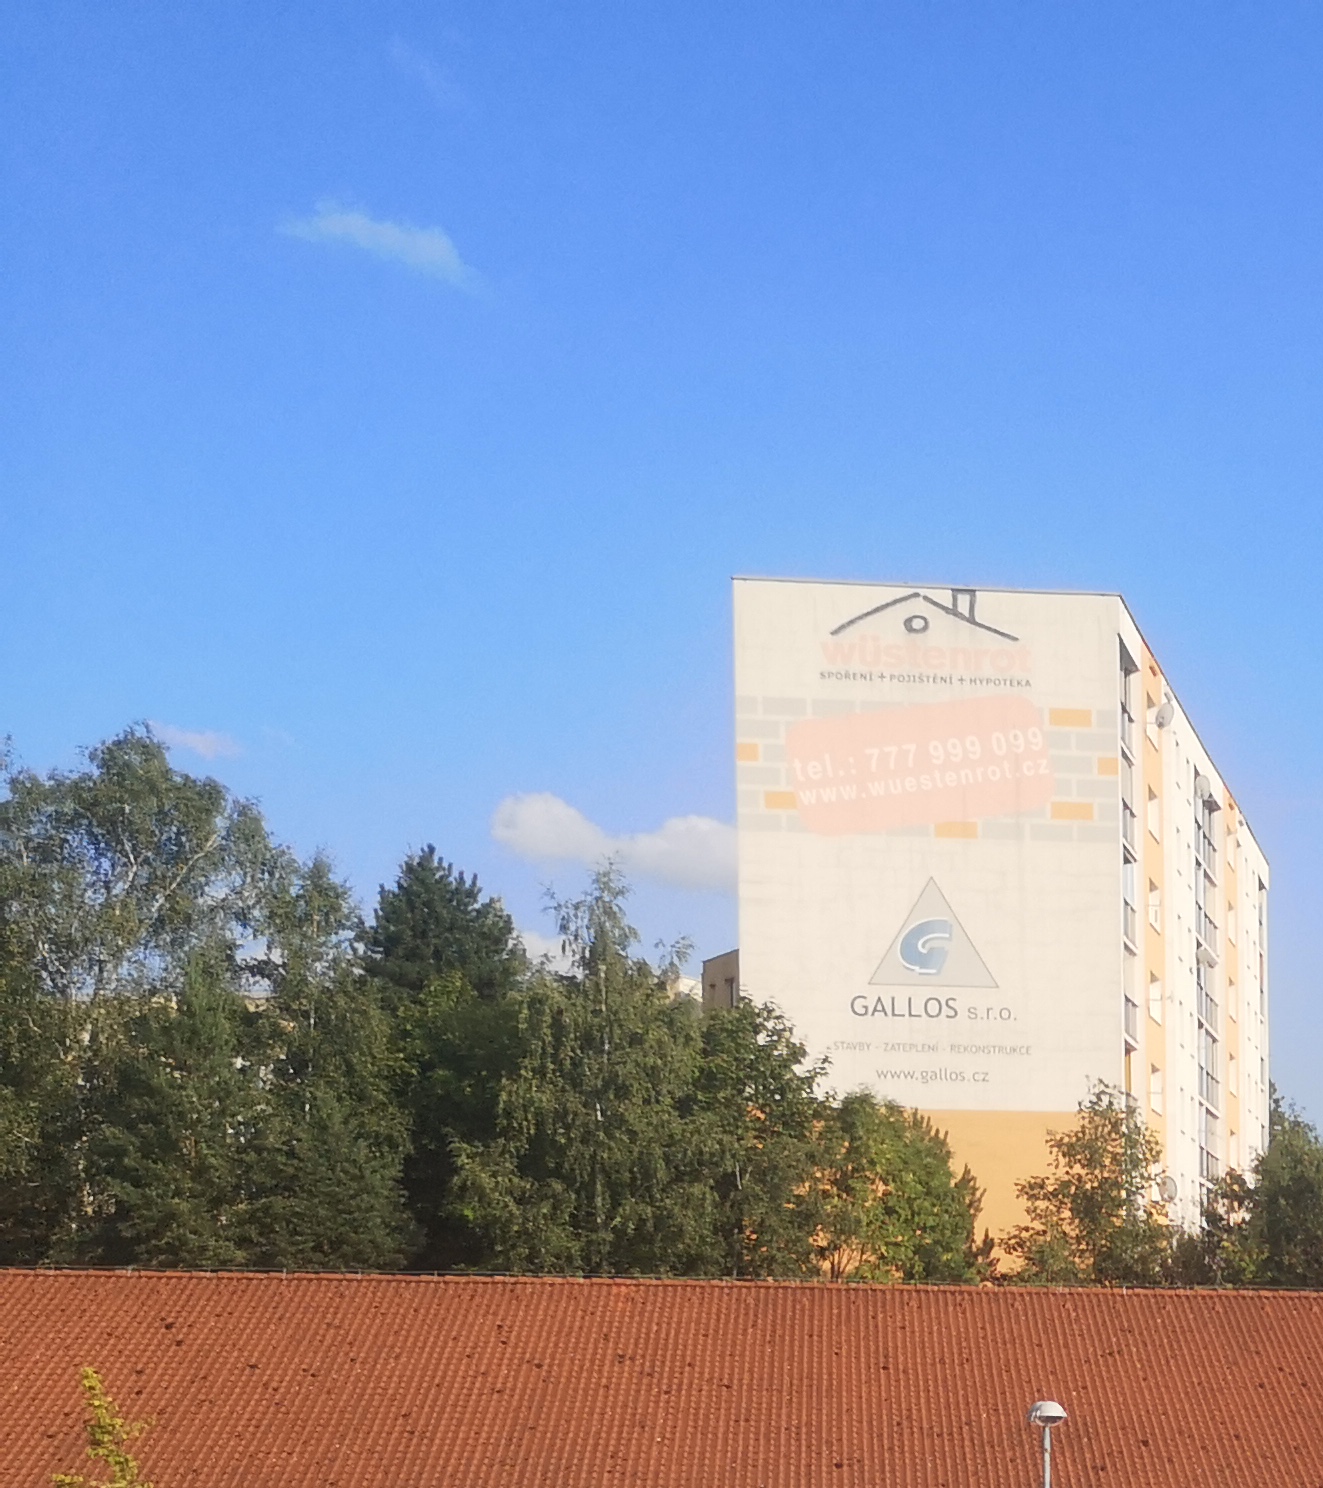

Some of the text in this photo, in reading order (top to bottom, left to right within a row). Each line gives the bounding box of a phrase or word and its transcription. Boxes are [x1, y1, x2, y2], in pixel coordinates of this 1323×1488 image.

[820, 634, 1032, 673] wüstenrot
[793, 726, 1044, 782] tel.: 777 999 099
[799, 757, 1051, 806] www.wuestenrot.cz
[850, 995, 1018, 1021] GALLOS s.r.o.
[833, 1041, 872, 1052] STAVBY
[950, 1044, 1032, 1056] REKONSTRUKCE
[876, 1067, 990, 1084] www.gallos.cz
